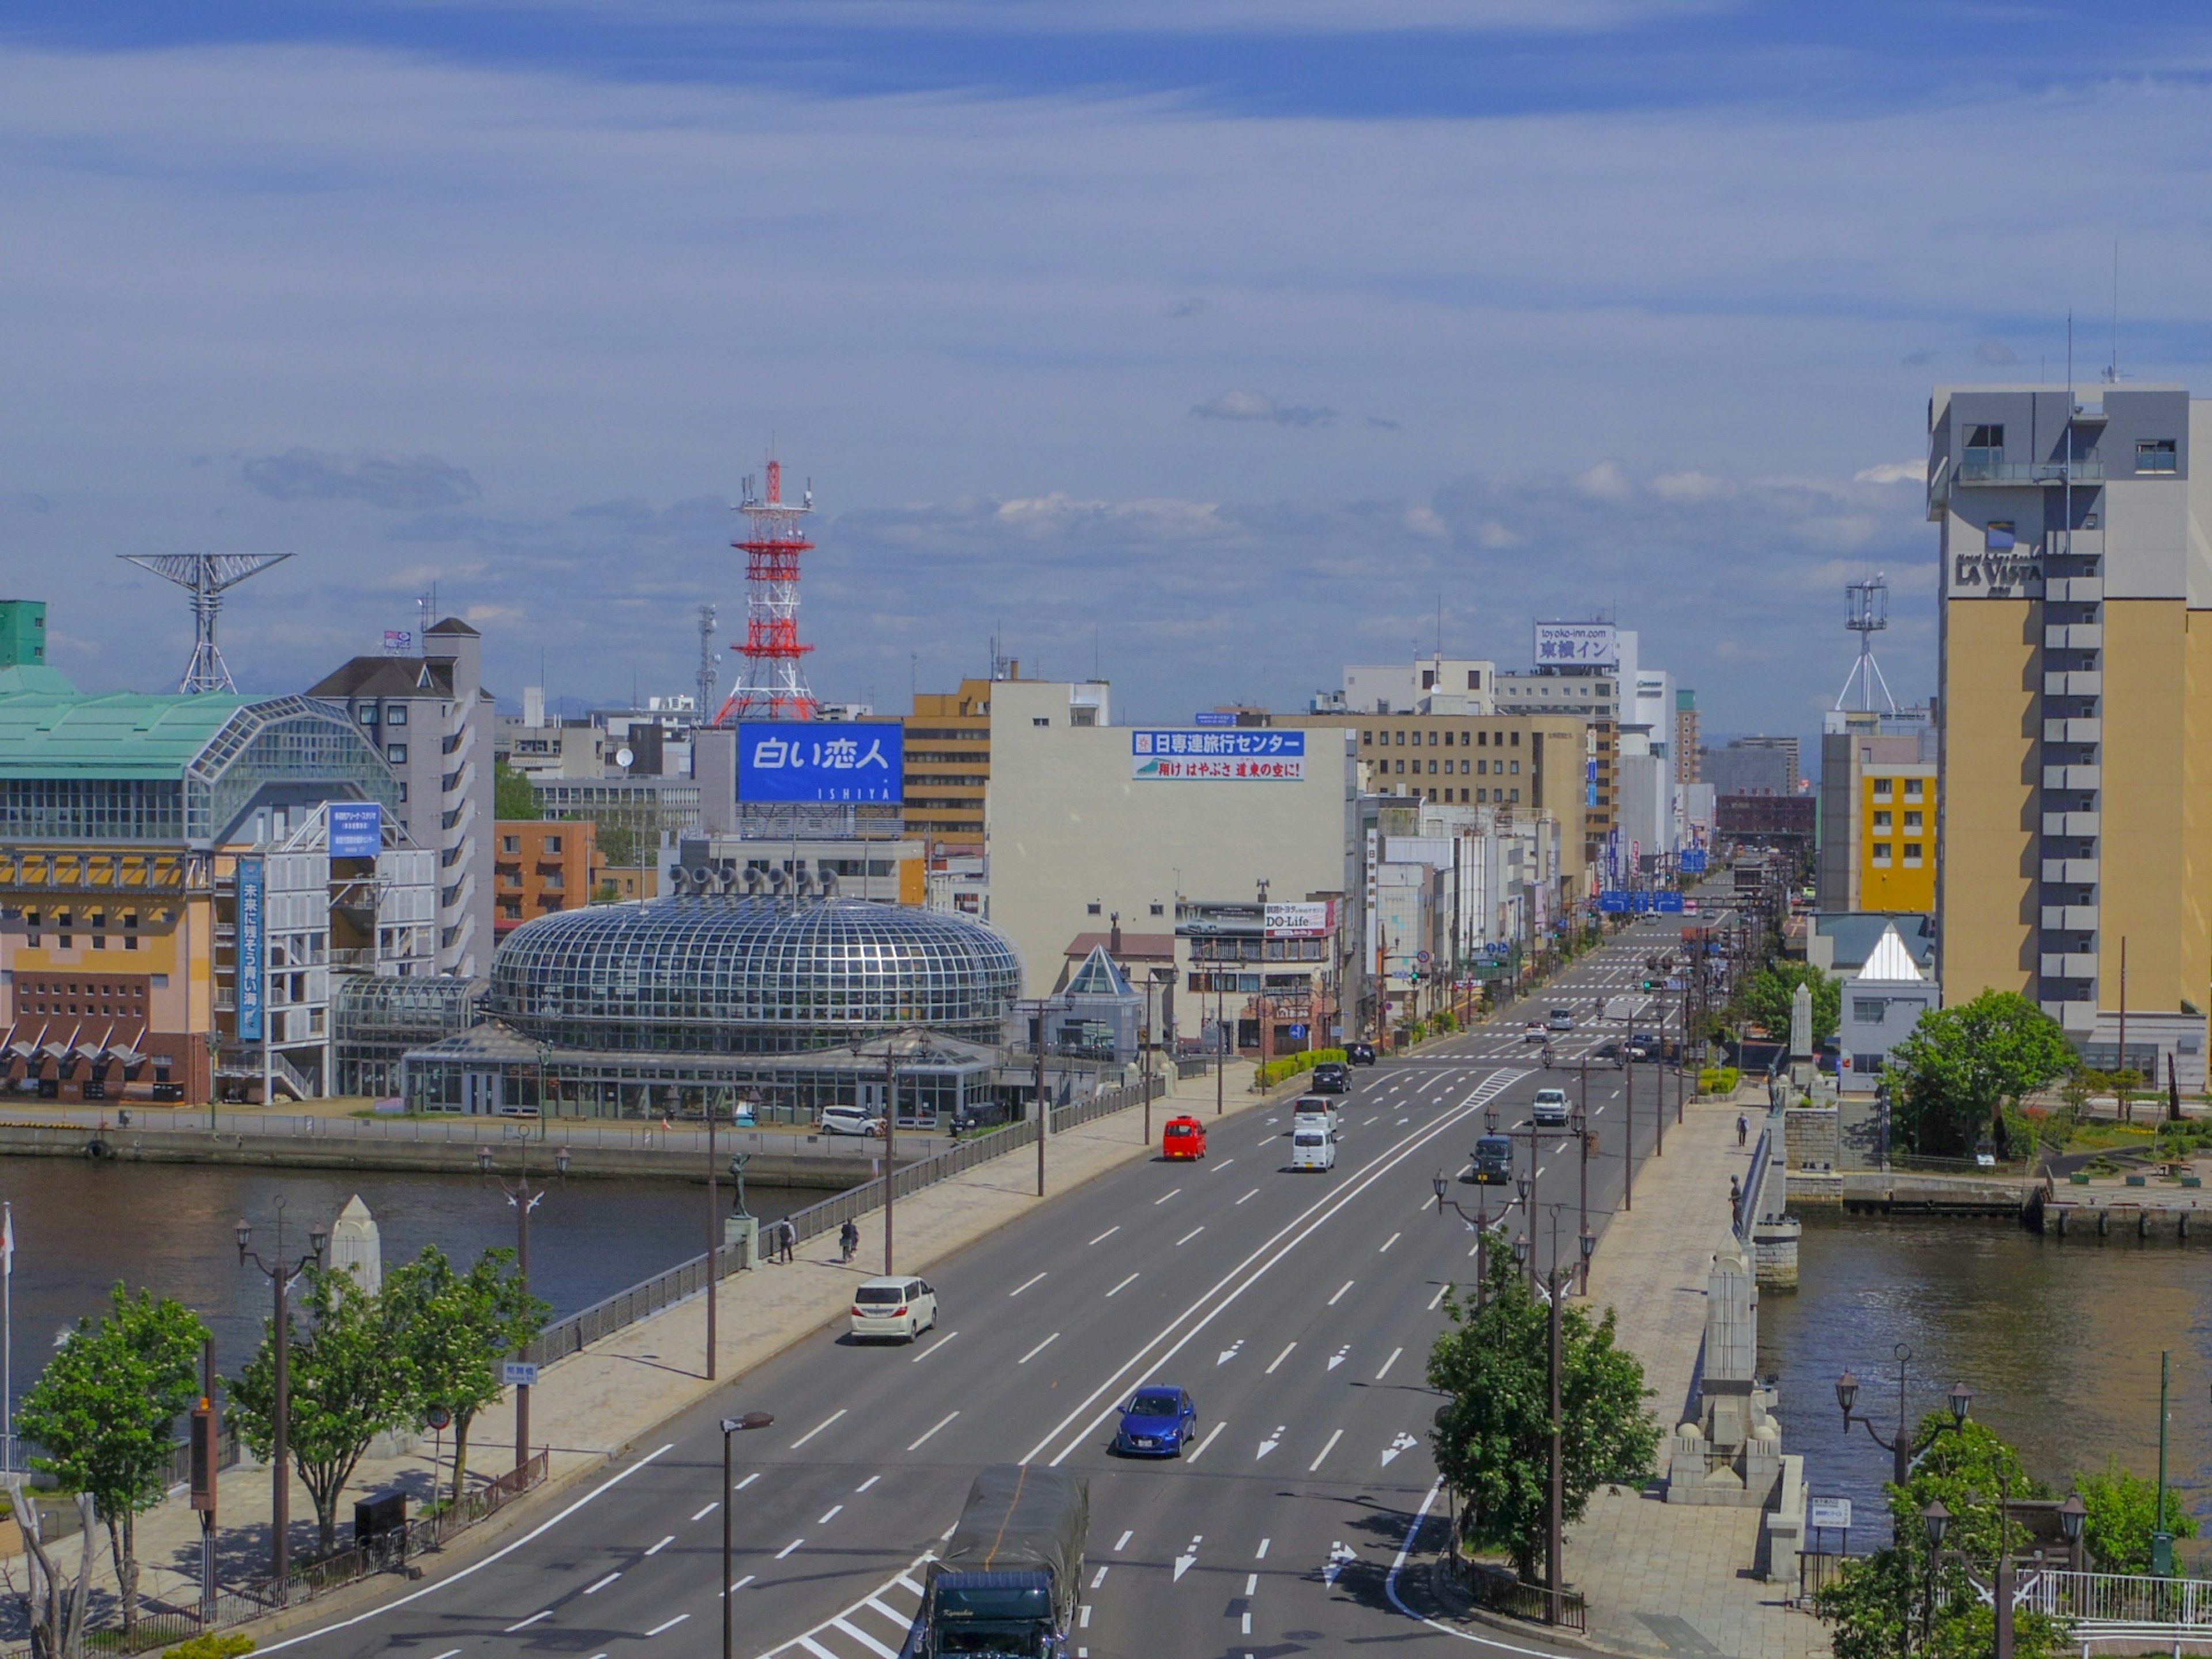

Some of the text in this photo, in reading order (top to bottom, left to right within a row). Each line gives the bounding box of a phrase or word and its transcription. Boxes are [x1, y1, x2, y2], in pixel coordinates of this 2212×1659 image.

[1957, 561, 2043, 582] LA VISTA
[1542, 628, 1606, 640] toyoko-inn.com
[1539, 641, 1608, 659] 東横イン
[753, 737, 889, 768] 白い恋人
[1156, 734, 1300, 753] 日専連旅行センター
[1158, 763, 1181, 777] 翔け
[1187, 763, 1231, 777] はやぶさ
[818, 788, 889, 800] ISHIYA
[244, 884, 257, 1006] 未来に残そう青い海
